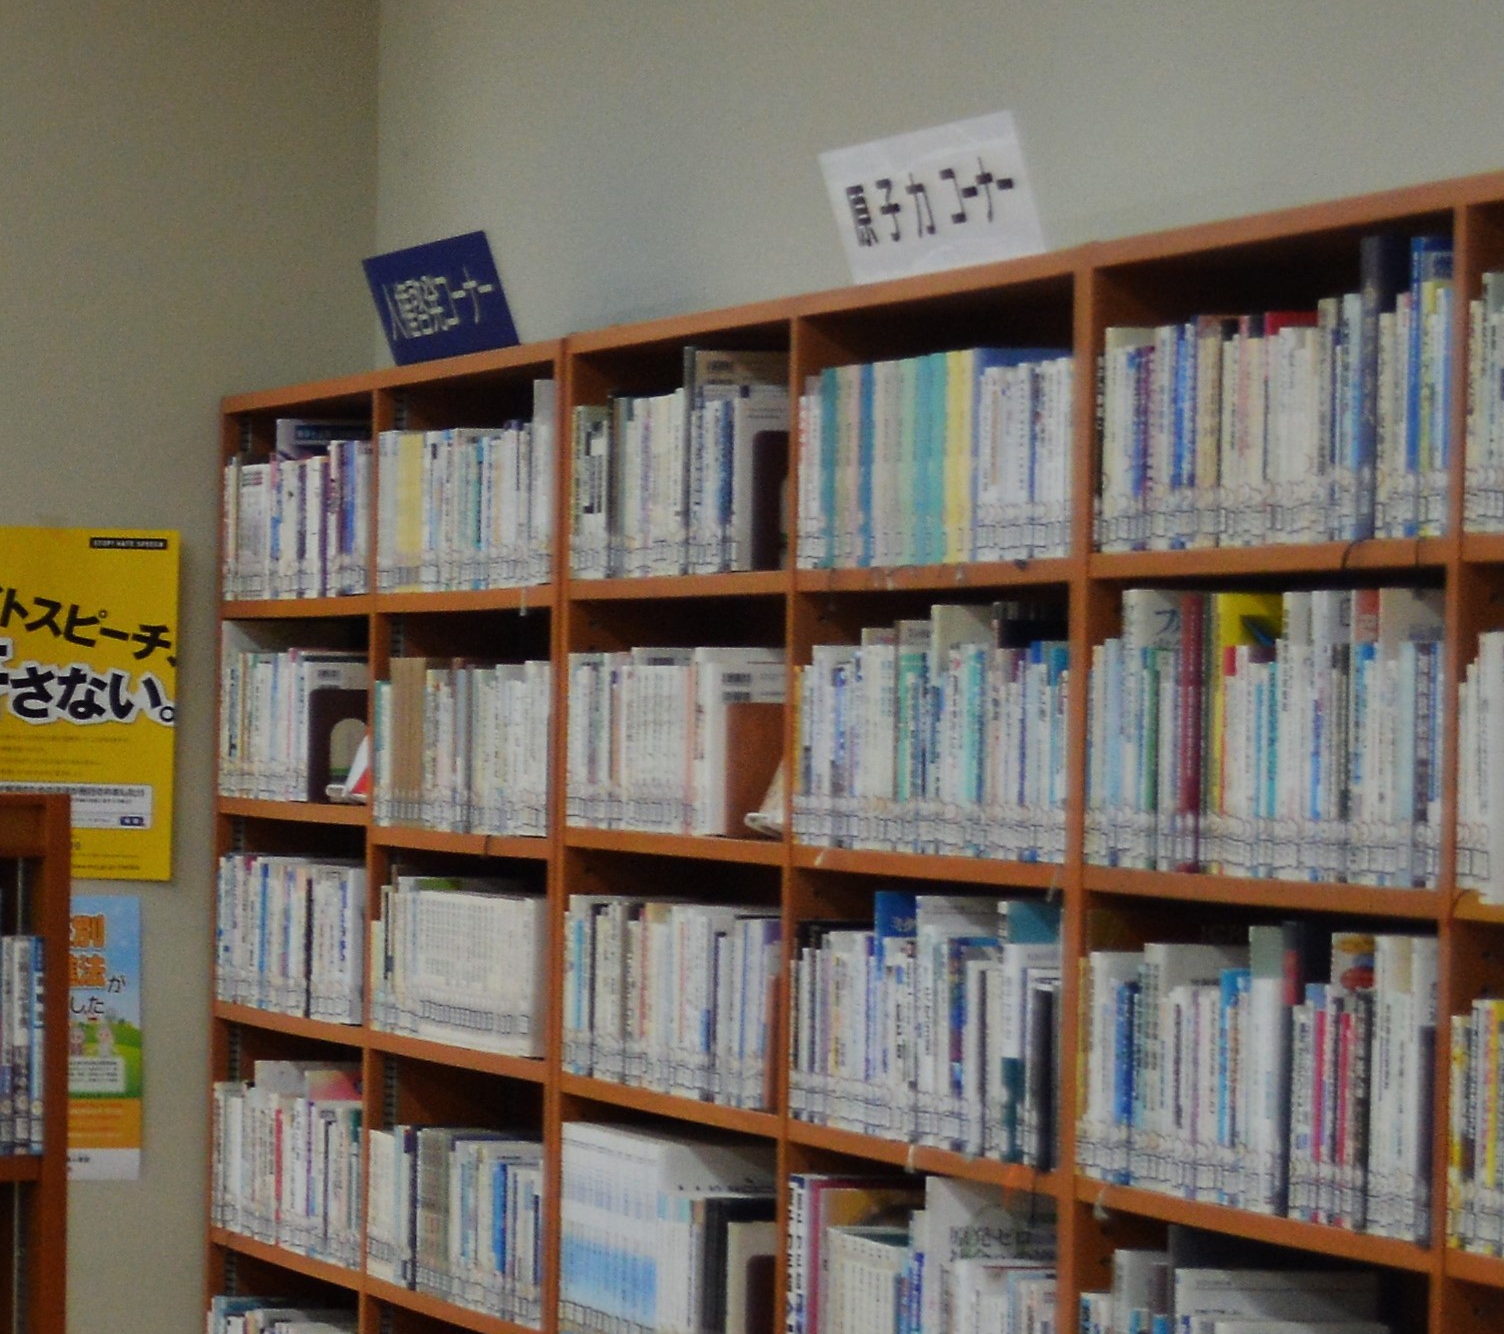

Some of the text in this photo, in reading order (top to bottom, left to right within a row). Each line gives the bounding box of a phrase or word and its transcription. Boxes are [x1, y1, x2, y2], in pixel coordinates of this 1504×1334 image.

[845, 156, 1016, 249] 原子力コーナー
